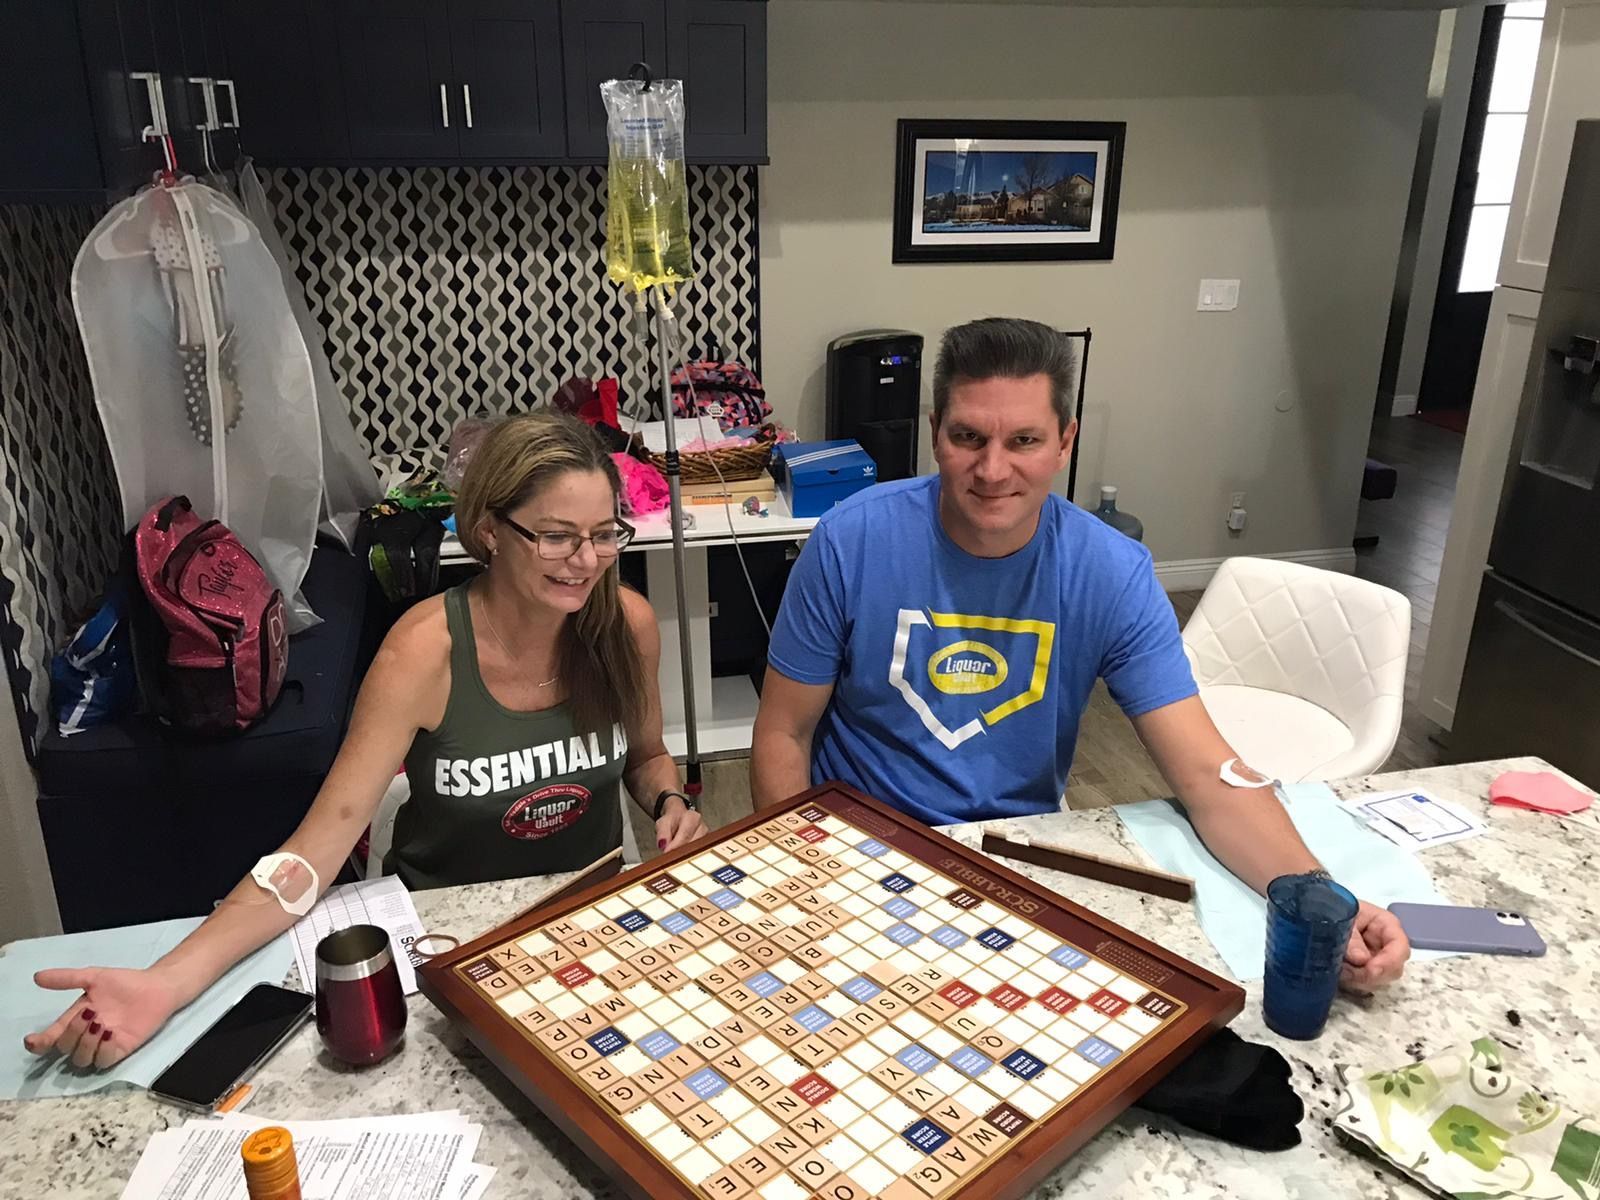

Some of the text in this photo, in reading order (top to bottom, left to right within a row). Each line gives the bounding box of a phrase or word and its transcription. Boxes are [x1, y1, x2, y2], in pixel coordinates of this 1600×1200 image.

[946, 656, 991, 675] Liquor
[435, 732, 606, 797] ESSENTIAL
[524, 799, 576, 821] Liquor
[944, 859, 1041, 914] SCRABBLE
